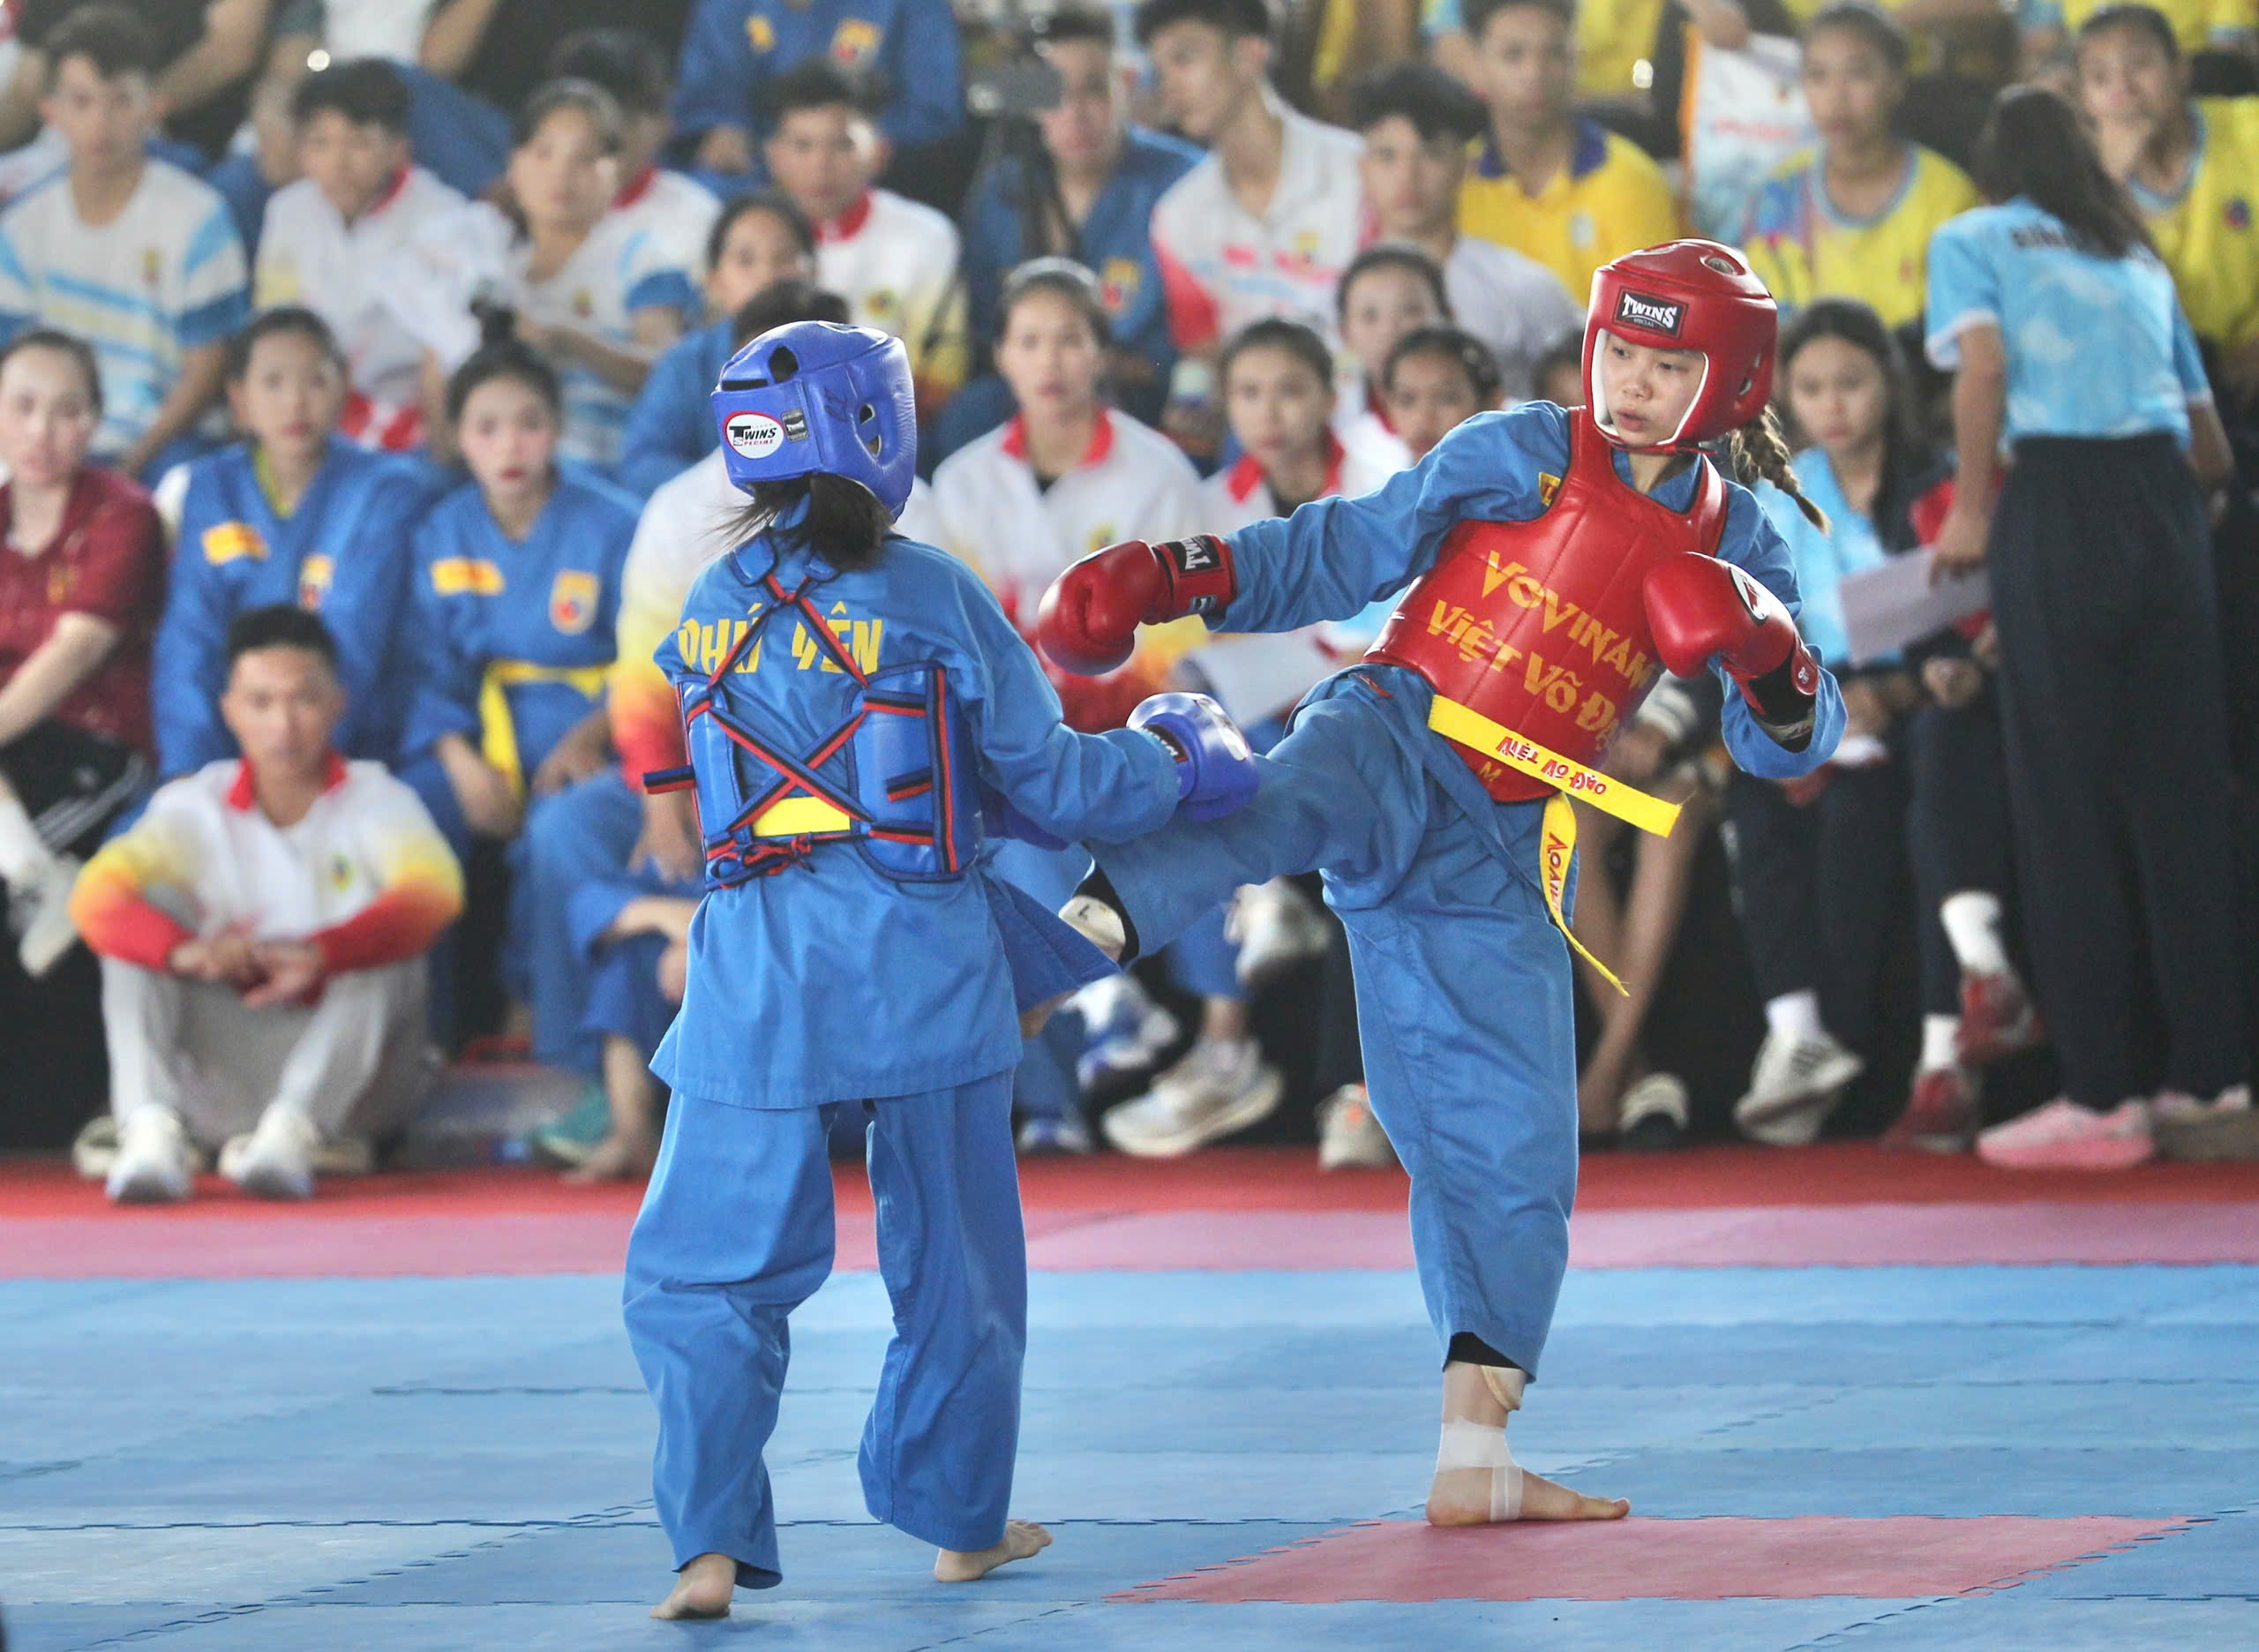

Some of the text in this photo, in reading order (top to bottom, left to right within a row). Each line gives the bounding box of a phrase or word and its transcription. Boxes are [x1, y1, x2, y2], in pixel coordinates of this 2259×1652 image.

[1622, 293, 1677, 329] TWINS
[729, 425, 777, 441] TWINS
[1482, 550, 1657, 690] VOVINAM
